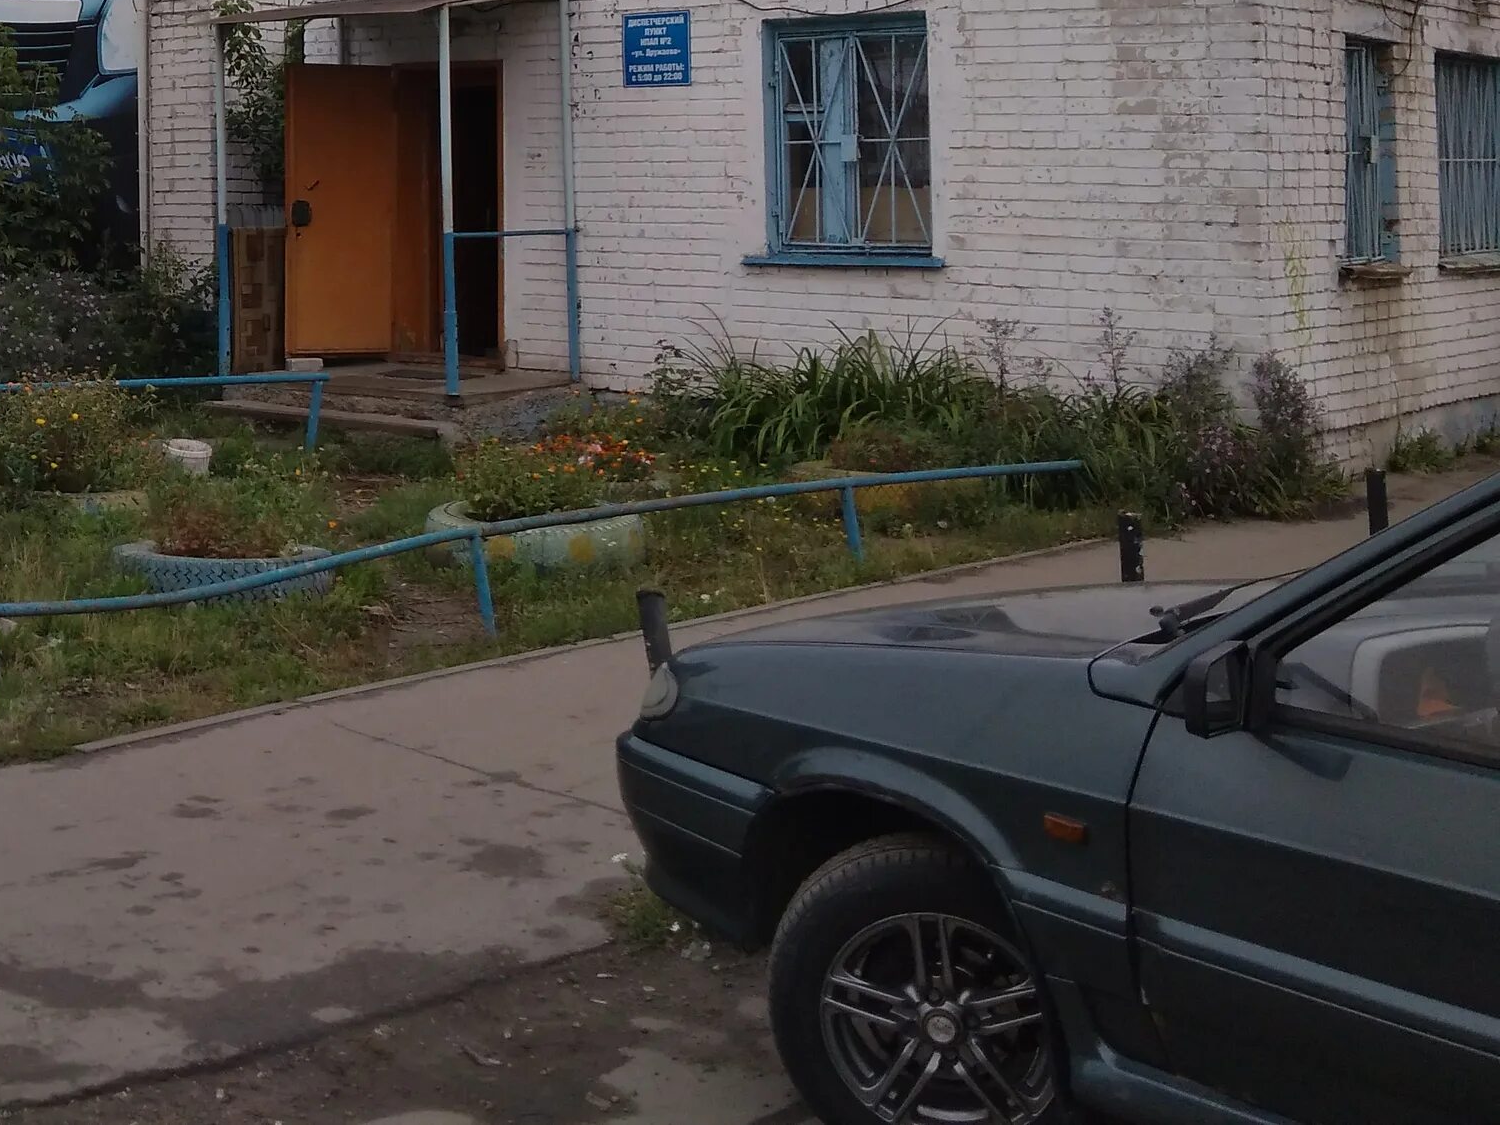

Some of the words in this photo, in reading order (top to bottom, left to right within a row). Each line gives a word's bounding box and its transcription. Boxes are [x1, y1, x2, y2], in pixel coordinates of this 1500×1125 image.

[644, 27, 667, 36] ПУНКТ
[629, 64, 654, 73] РЕЖИМ
[655, 62, 685, 72] РАБОТЫ:
